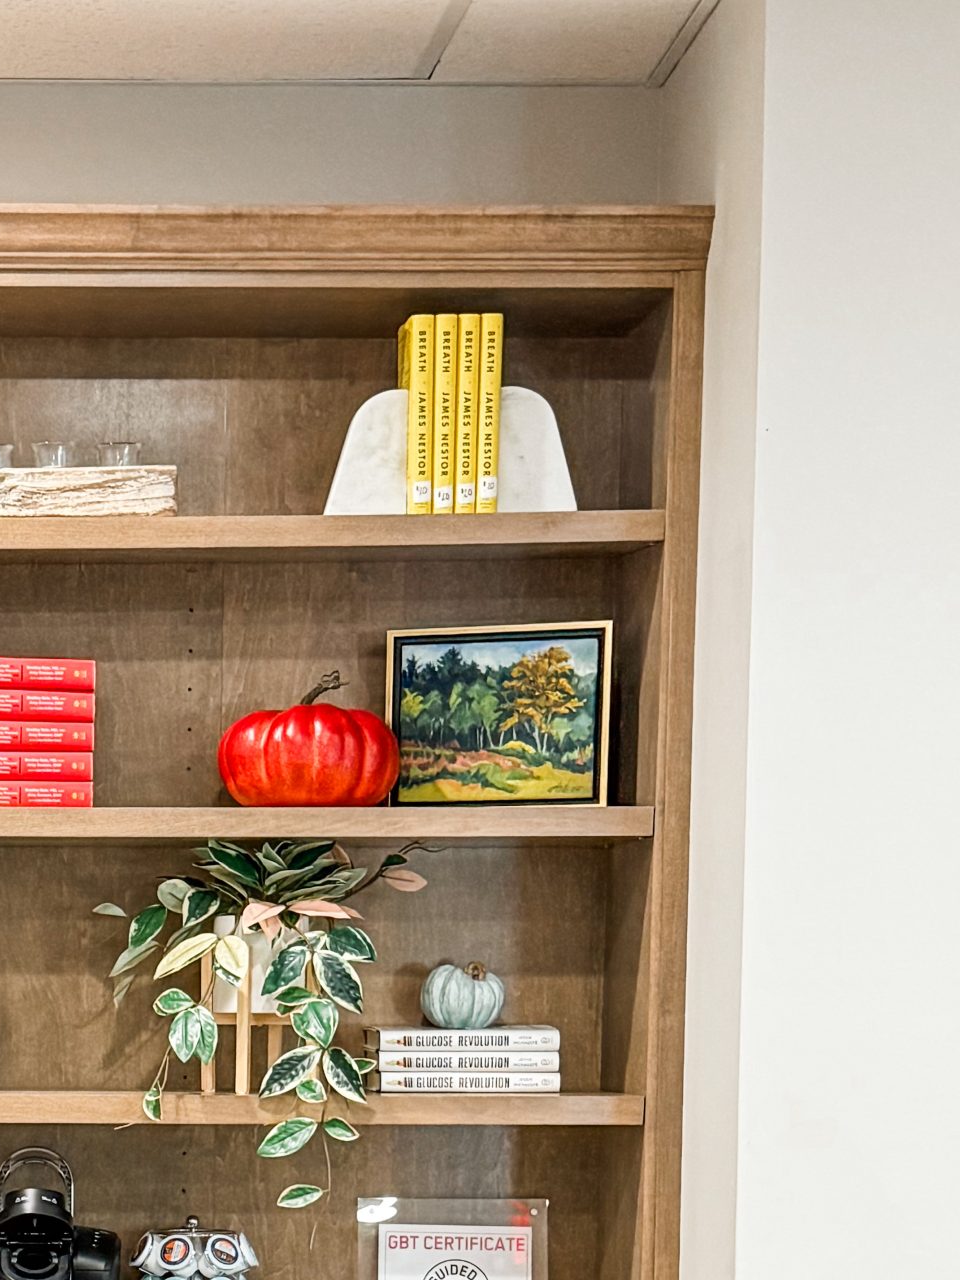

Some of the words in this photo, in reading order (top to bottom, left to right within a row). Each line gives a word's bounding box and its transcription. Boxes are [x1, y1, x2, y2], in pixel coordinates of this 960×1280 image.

[418, 330, 427, 372] BREATH
[442, 331, 451, 373] BREATH
[464, 330, 473, 372] BREATH
[486, 331, 496, 373] BREATH
[418, 391, 427, 427] JAMES
[441, 391, 450, 427] JAMES
[463, 390, 472, 427] JAMES
[484, 391, 494, 427] JAMES
[417, 433, 427, 476] NESTOR
[440, 433, 449, 476] NESTOR
[461, 432, 470, 476] NESTOR
[483, 433, 492, 476] NESTOR
[415, 1035, 453, 1047] GLUCOSE
[458, 1035, 510, 1047] REVOLUTION
[415, 1057, 453, 1068] GLUCOSE
[458, 1057, 510, 1068] REVOLUTION
[416, 1077, 453, 1089] GLUCOSE
[458, 1077, 510, 1089] REVOLUTION
[388, 1235, 419, 1250] GBT
[423, 1235, 526, 1252] CERTIFICATE
